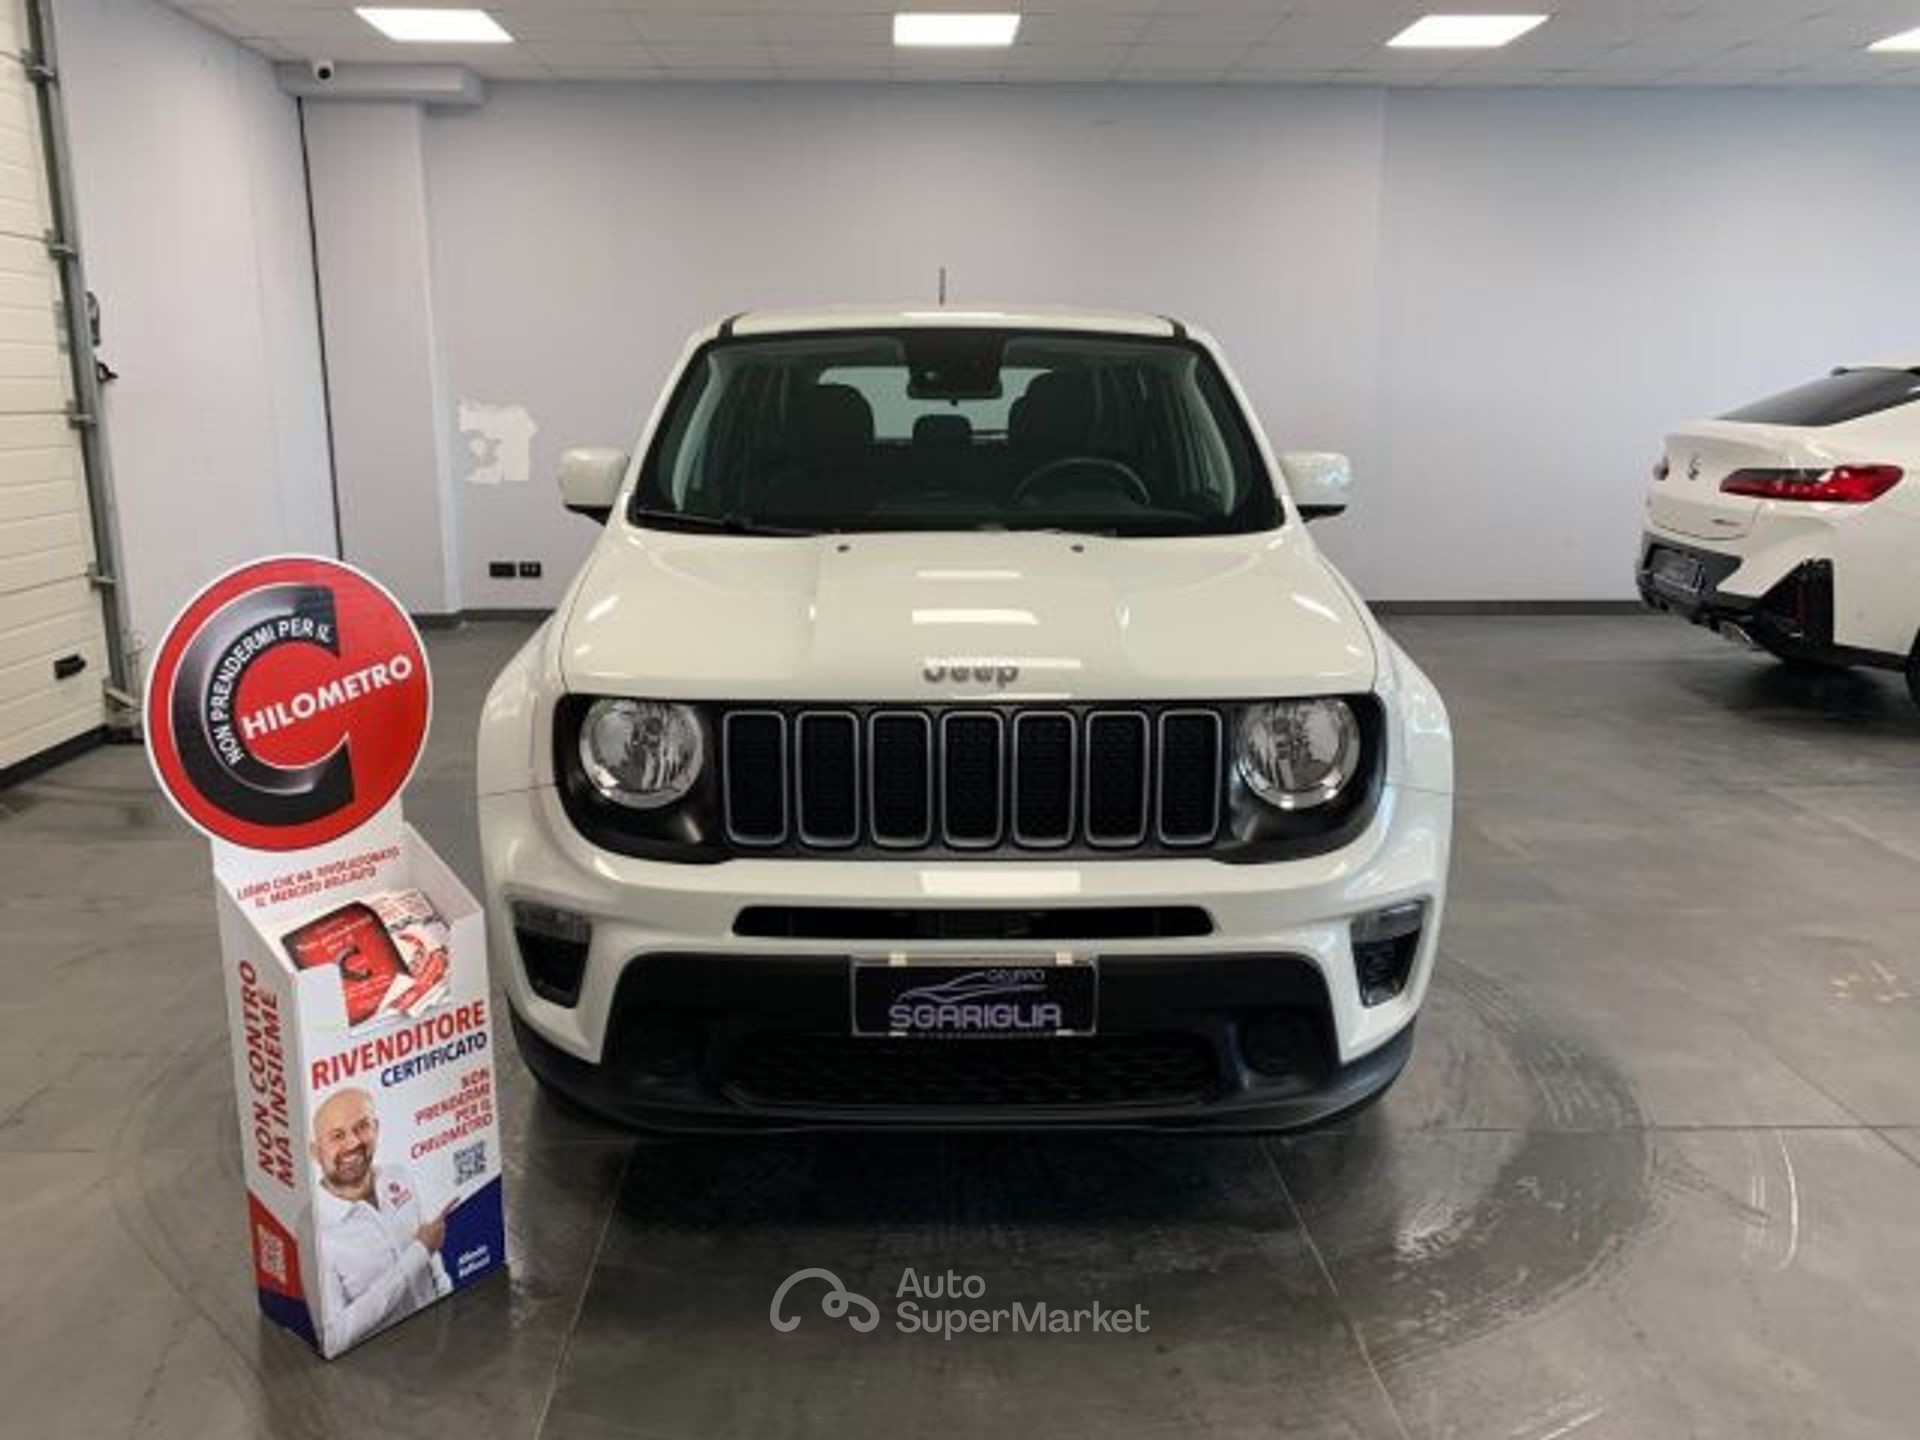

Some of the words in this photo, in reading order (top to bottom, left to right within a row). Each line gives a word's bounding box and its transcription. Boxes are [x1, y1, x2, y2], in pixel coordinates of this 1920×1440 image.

[277, 617, 314, 639] PER
[315, 623, 334, 644] IL
[210, 627, 276, 722] PRENDERMI
[239, 654, 413, 740] HILOMETRO
[922, 656, 1019, 688] Jeep
[212, 725, 245, 766] NON
[239, 959, 268, 1094] CONTRO
[888, 1004, 1062, 1029] SGARIGLIA
[265, 993, 289, 1129] INSIEME
[310, 1000, 486, 1090] RIVENDITORE
[380, 1031, 488, 1087] CERTIFICATO
[254, 1108, 275, 1175] NON
[272, 1134, 296, 1188] MA
